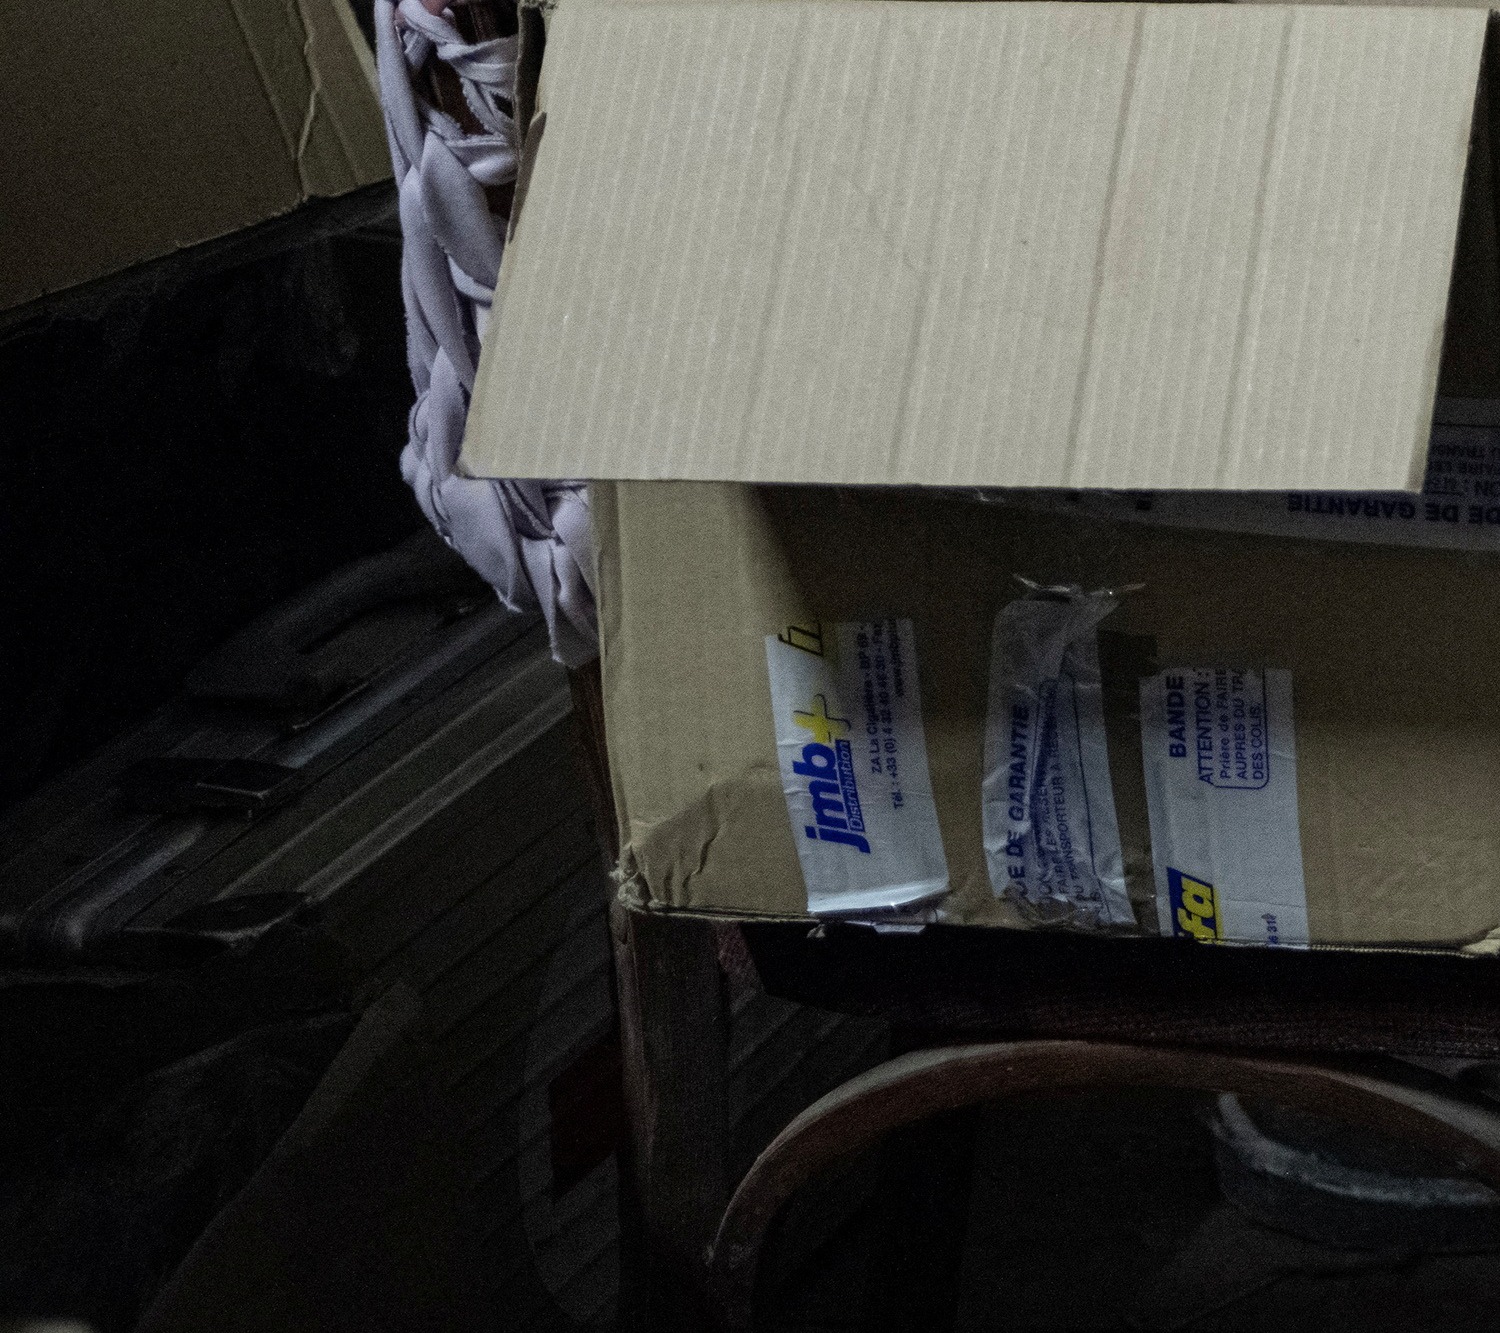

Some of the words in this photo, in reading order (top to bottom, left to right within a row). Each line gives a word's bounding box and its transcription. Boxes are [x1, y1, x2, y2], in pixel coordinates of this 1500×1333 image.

[1287, 492, 1418, 523] GARANTIE
[1425, 503, 1459, 522] DE
[1166, 675, 1187, 759] BANDE
[1216, 714, 1230, 733] de
[1232, 698, 1246, 720] DU
[1193, 682, 1214, 784] ATTENTION
[1232, 723, 1248, 781] AUPRES
[836, 739, 864, 832] Distribution
[1007, 704, 1029, 823] GARANTIE
[1251, 753, 1265, 781] DES
